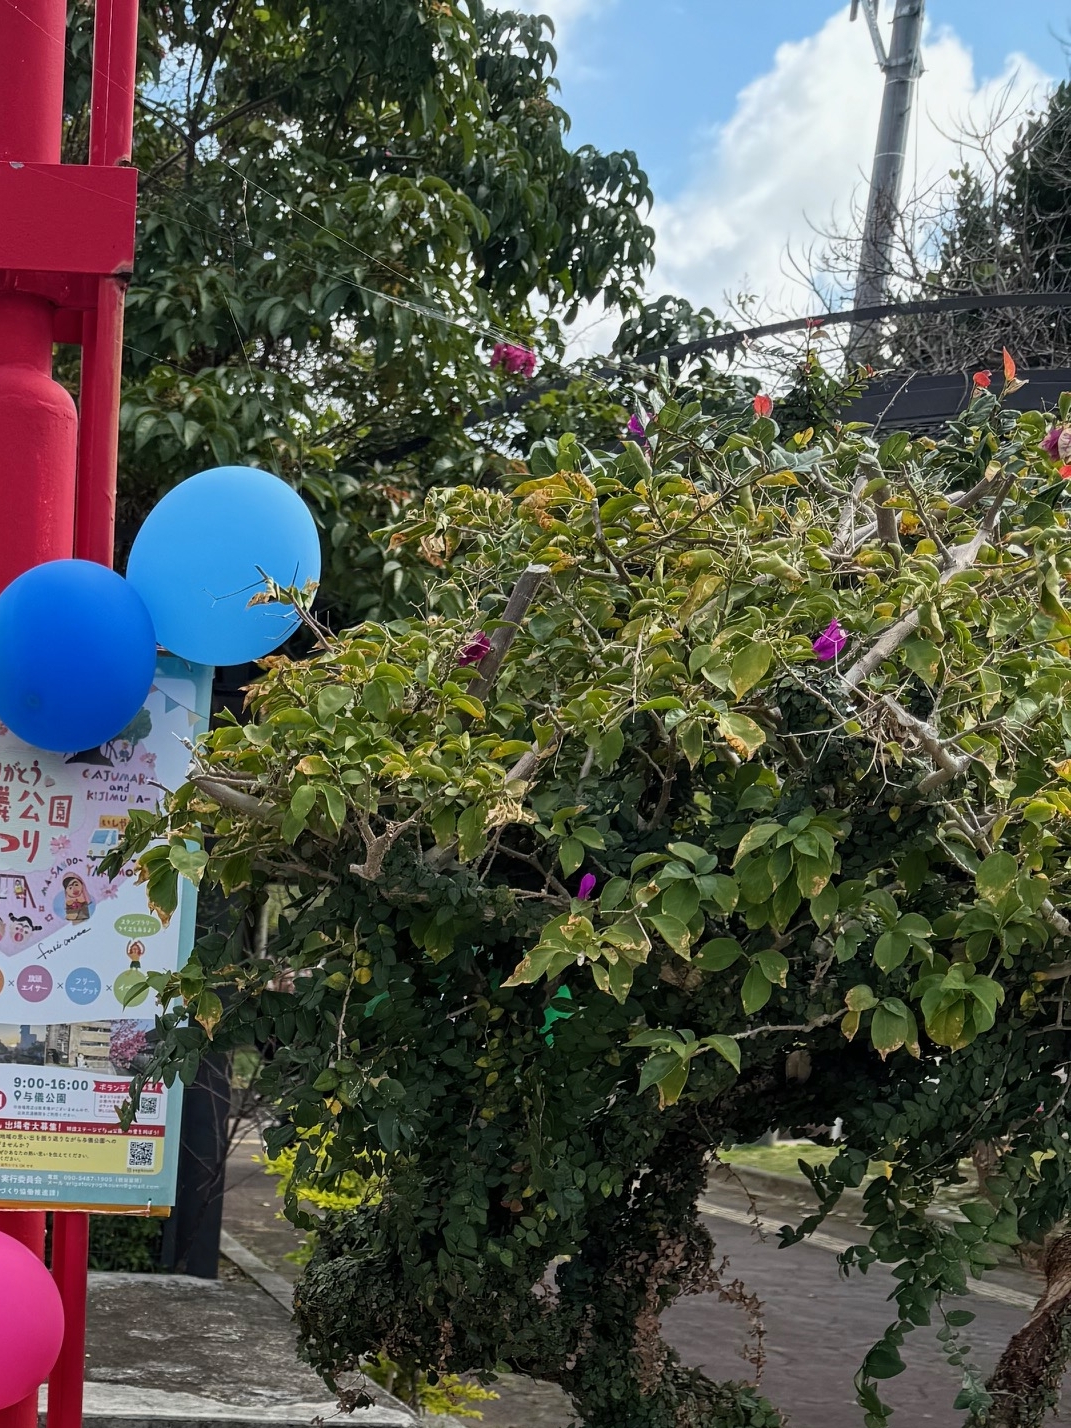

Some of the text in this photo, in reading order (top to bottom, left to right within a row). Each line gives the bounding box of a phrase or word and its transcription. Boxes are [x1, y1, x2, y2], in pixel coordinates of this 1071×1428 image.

[109, 783, 130, 793] and
[20, 984, 48, 992] エイサー
[69, 987, 99, 995] マーケット
[14, 1077, 89, 1091] 9:00-16:00
[23, 1092, 67, 1104] 与儀公園
